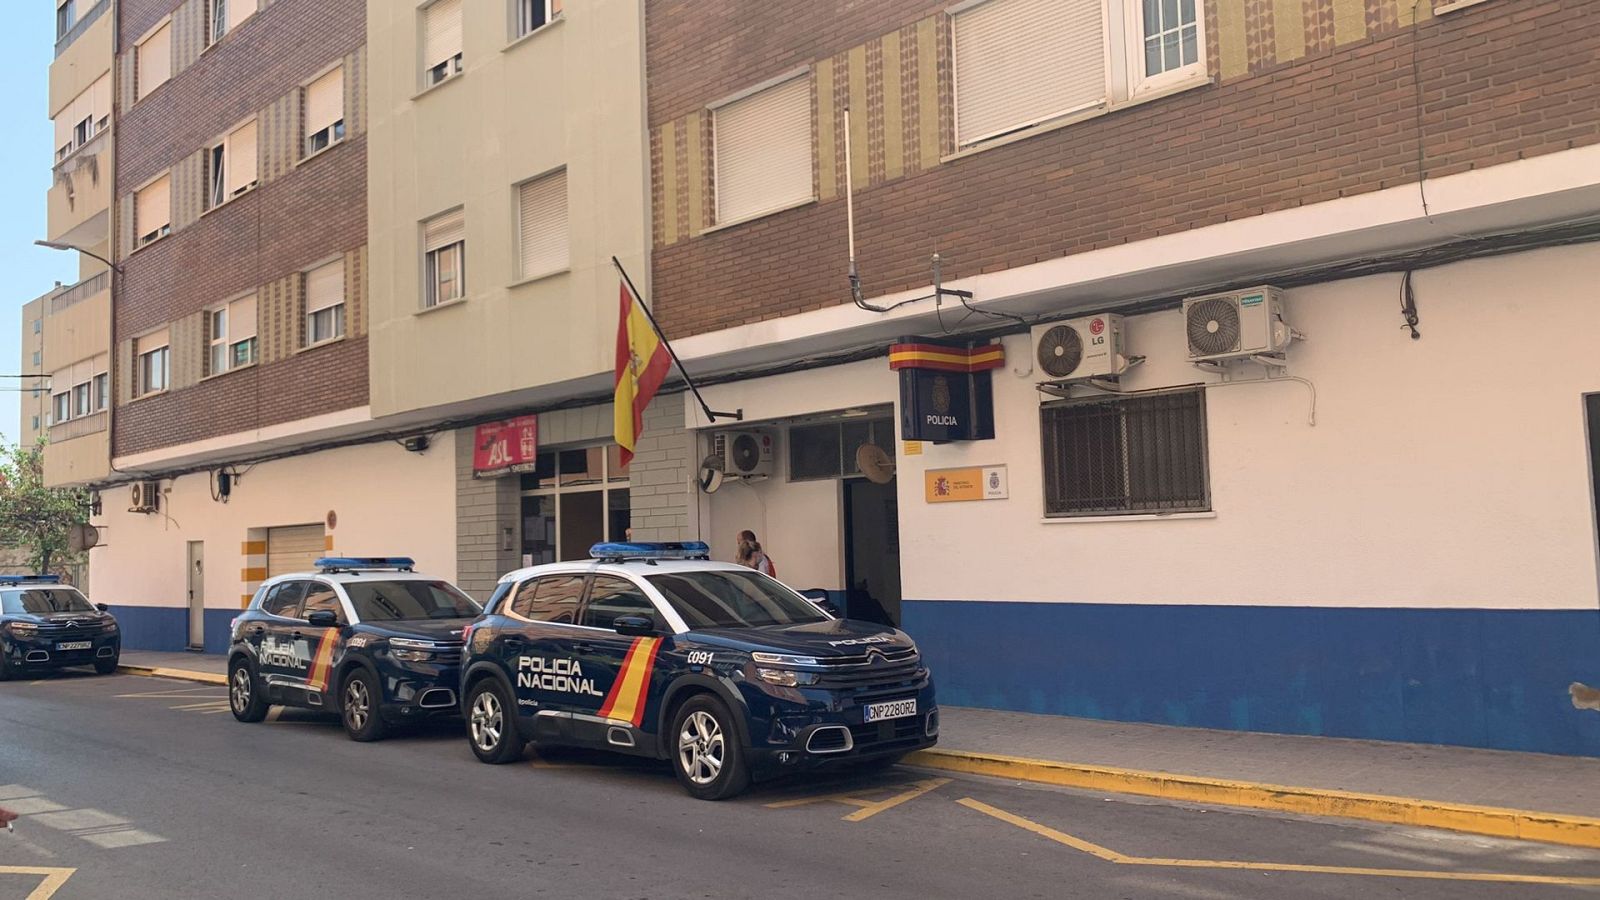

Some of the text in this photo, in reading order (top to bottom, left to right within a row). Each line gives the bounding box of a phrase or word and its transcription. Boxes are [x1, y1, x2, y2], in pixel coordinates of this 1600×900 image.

[1092, 336, 1104, 345] LG
[926, 415, 958, 426] POLICIA
[488, 439, 513, 466] ASL
[519, 656, 582, 676] POLICÍA
[517, 672, 604, 697] NACIONAL
[869, 701, 915, 720] CNP2280RZ
